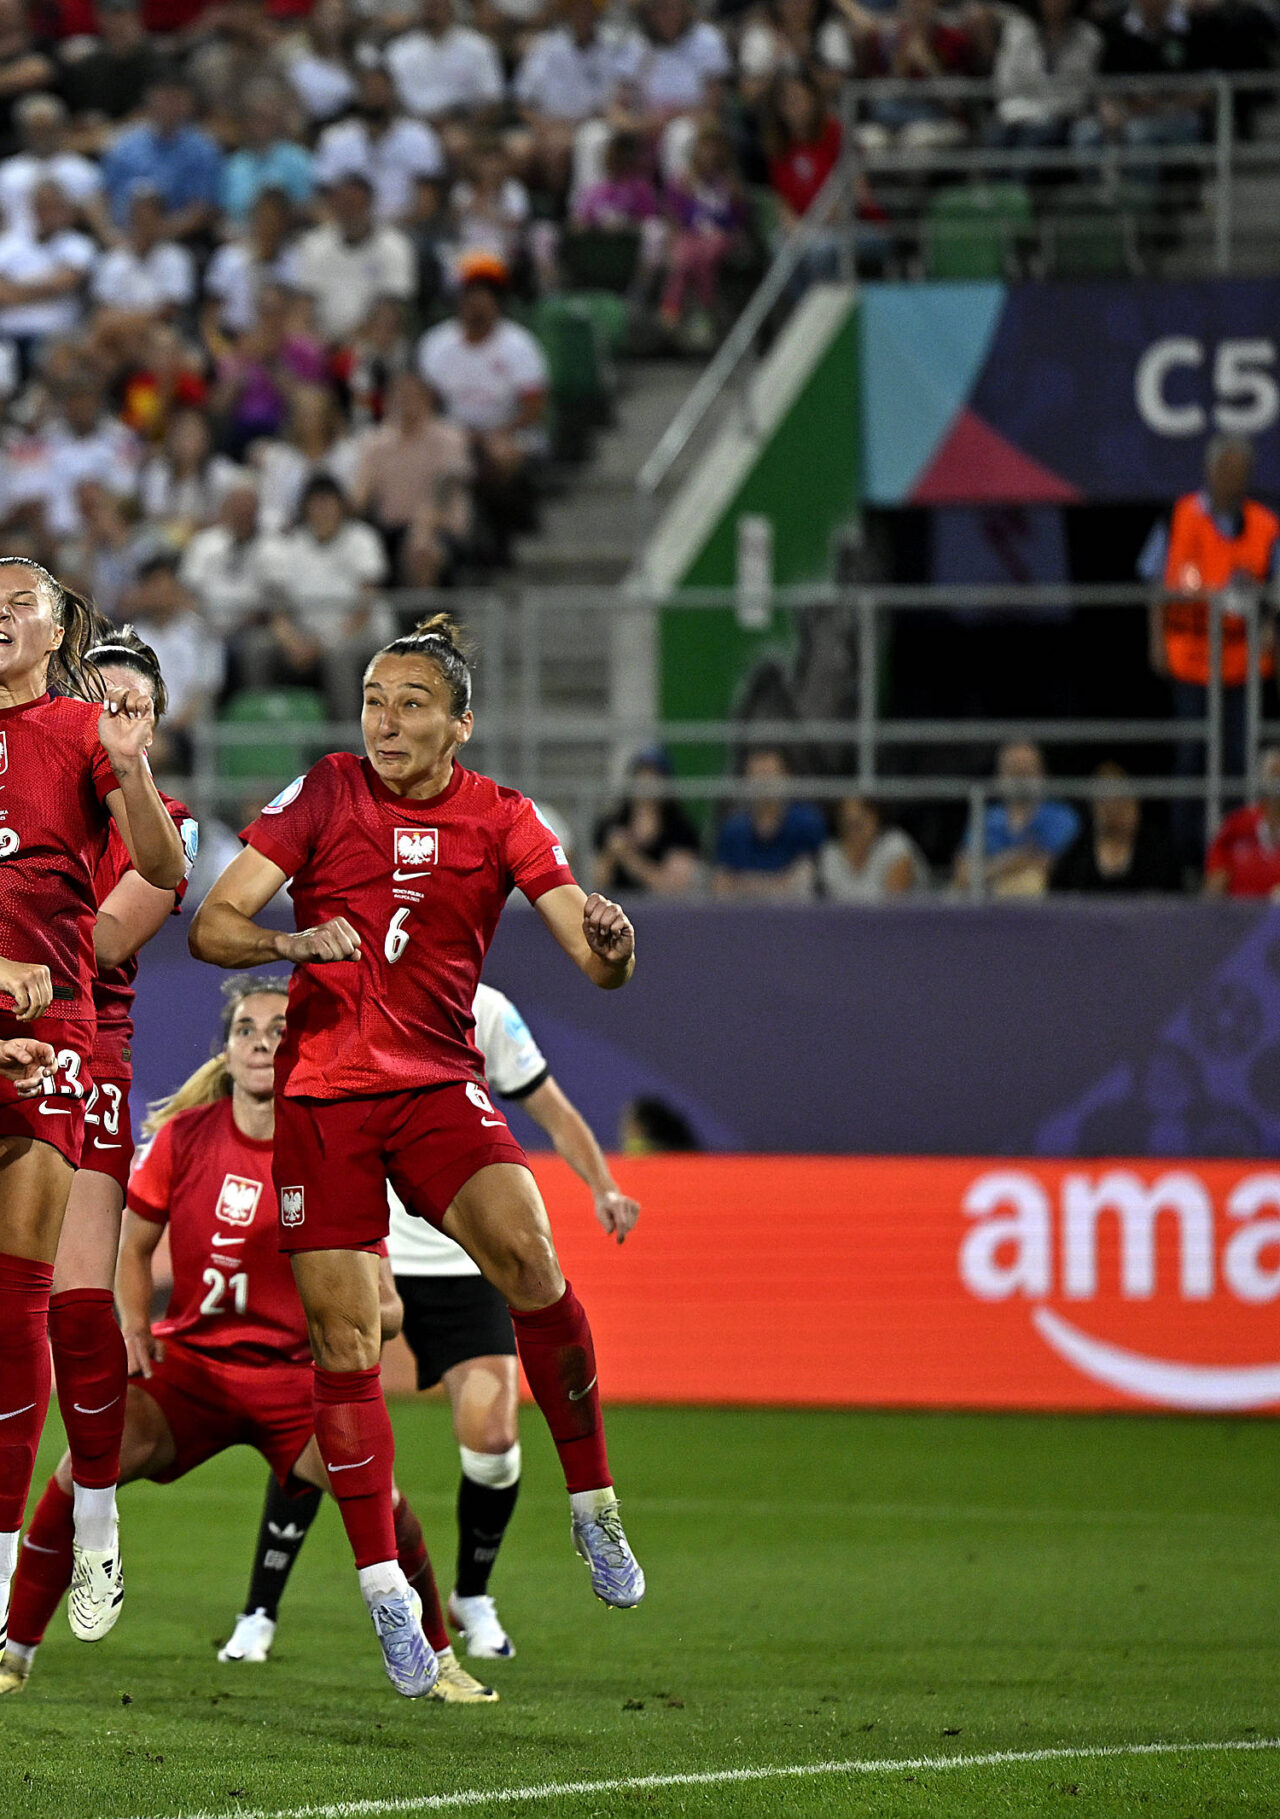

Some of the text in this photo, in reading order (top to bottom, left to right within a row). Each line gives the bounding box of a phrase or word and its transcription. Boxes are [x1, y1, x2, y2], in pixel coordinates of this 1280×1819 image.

[1135, 338, 1277, 435] C5
[384, 907, 410, 964] 6
[465, 1081, 495, 1115] 6
[958, 1169, 1280, 1304] ama
[200, 1267, 248, 1315] 21
